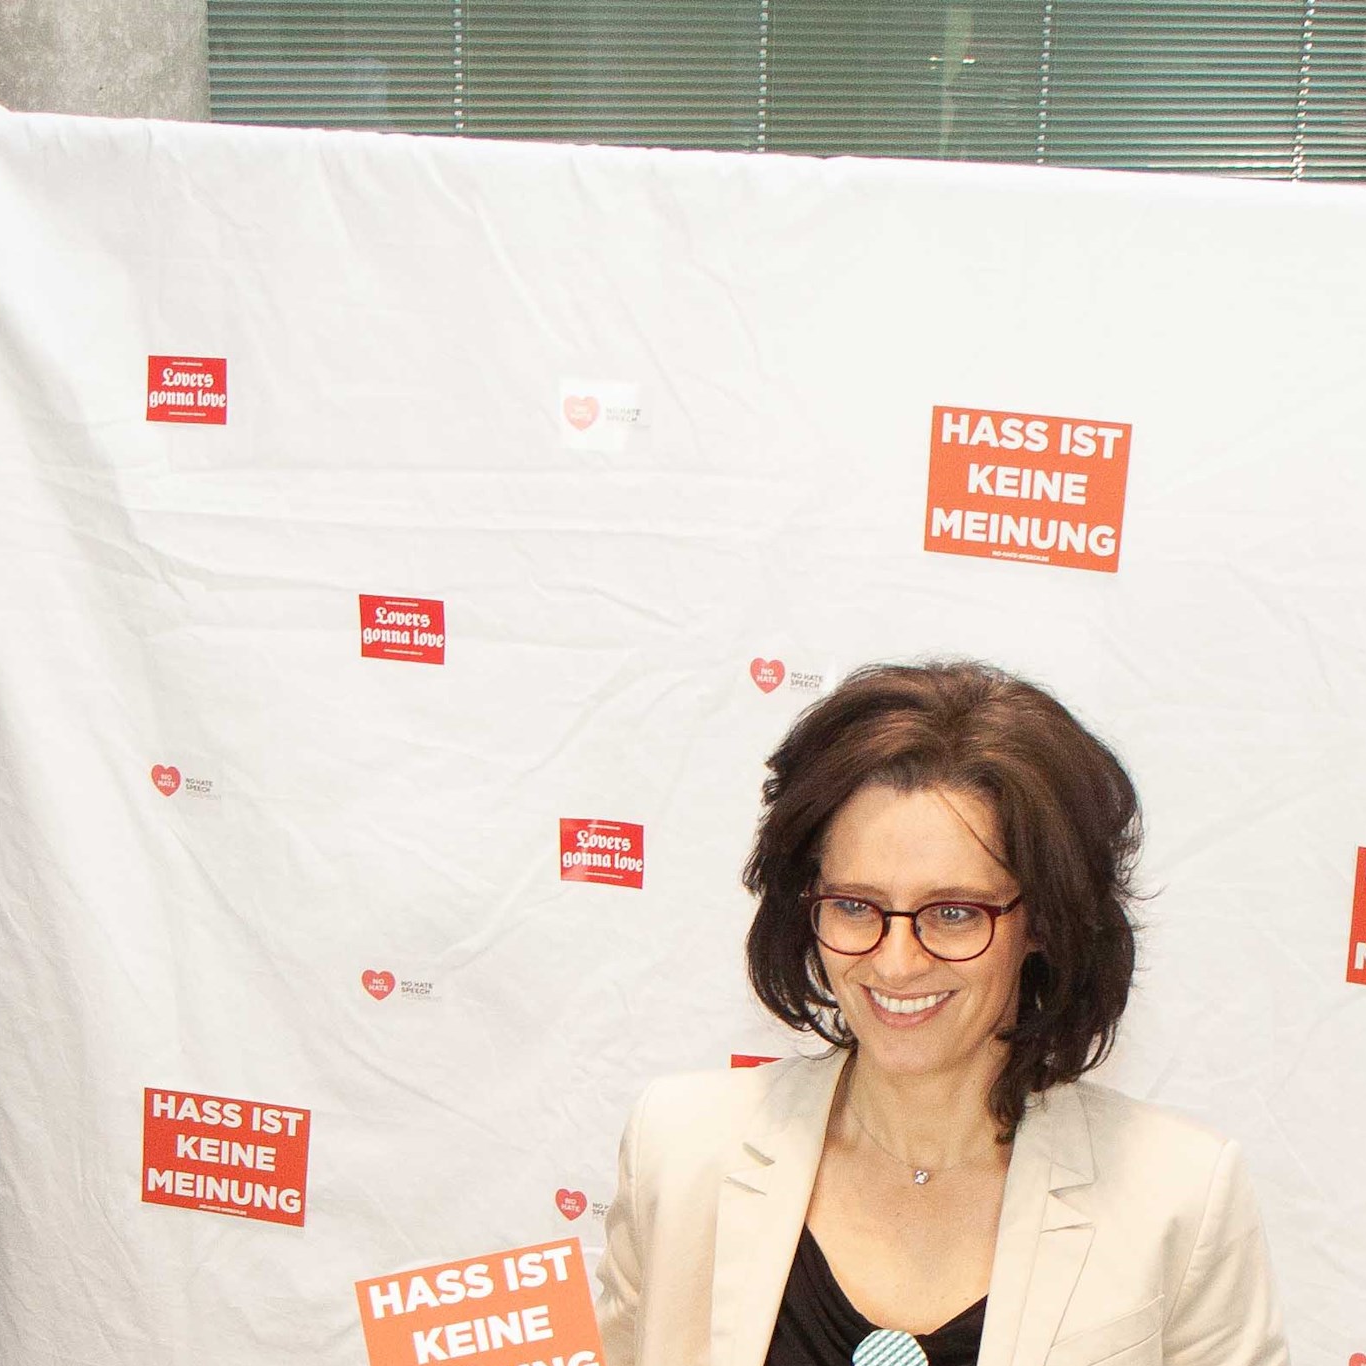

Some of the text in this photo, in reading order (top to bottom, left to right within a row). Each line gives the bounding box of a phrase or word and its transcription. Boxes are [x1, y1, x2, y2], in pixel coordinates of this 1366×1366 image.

[162, 368, 214, 388] Lovers
[149, 389, 227, 408] gonna love
[942, 412, 1123, 459] HASS IST
[968, 463, 1088, 505] KEINE
[931, 507, 1116, 557] MEINUNG
[375, 606, 431, 628] Lovers
[363, 627, 444, 648] gonna love
[791, 680, 820, 689] SPEECH
[804, 674, 823, 682] HATE
[576, 830, 631, 851] Lovers
[563, 852, 642, 872] gonna love
[153, 1093, 303, 1137] HASS IST
[177, 1134, 276, 1172] KEINE
[148, 1167, 301, 1213] MEINUNG
[369, 1246, 572, 1319] HASS IST
[413, 1305, 553, 1365] KEINE
